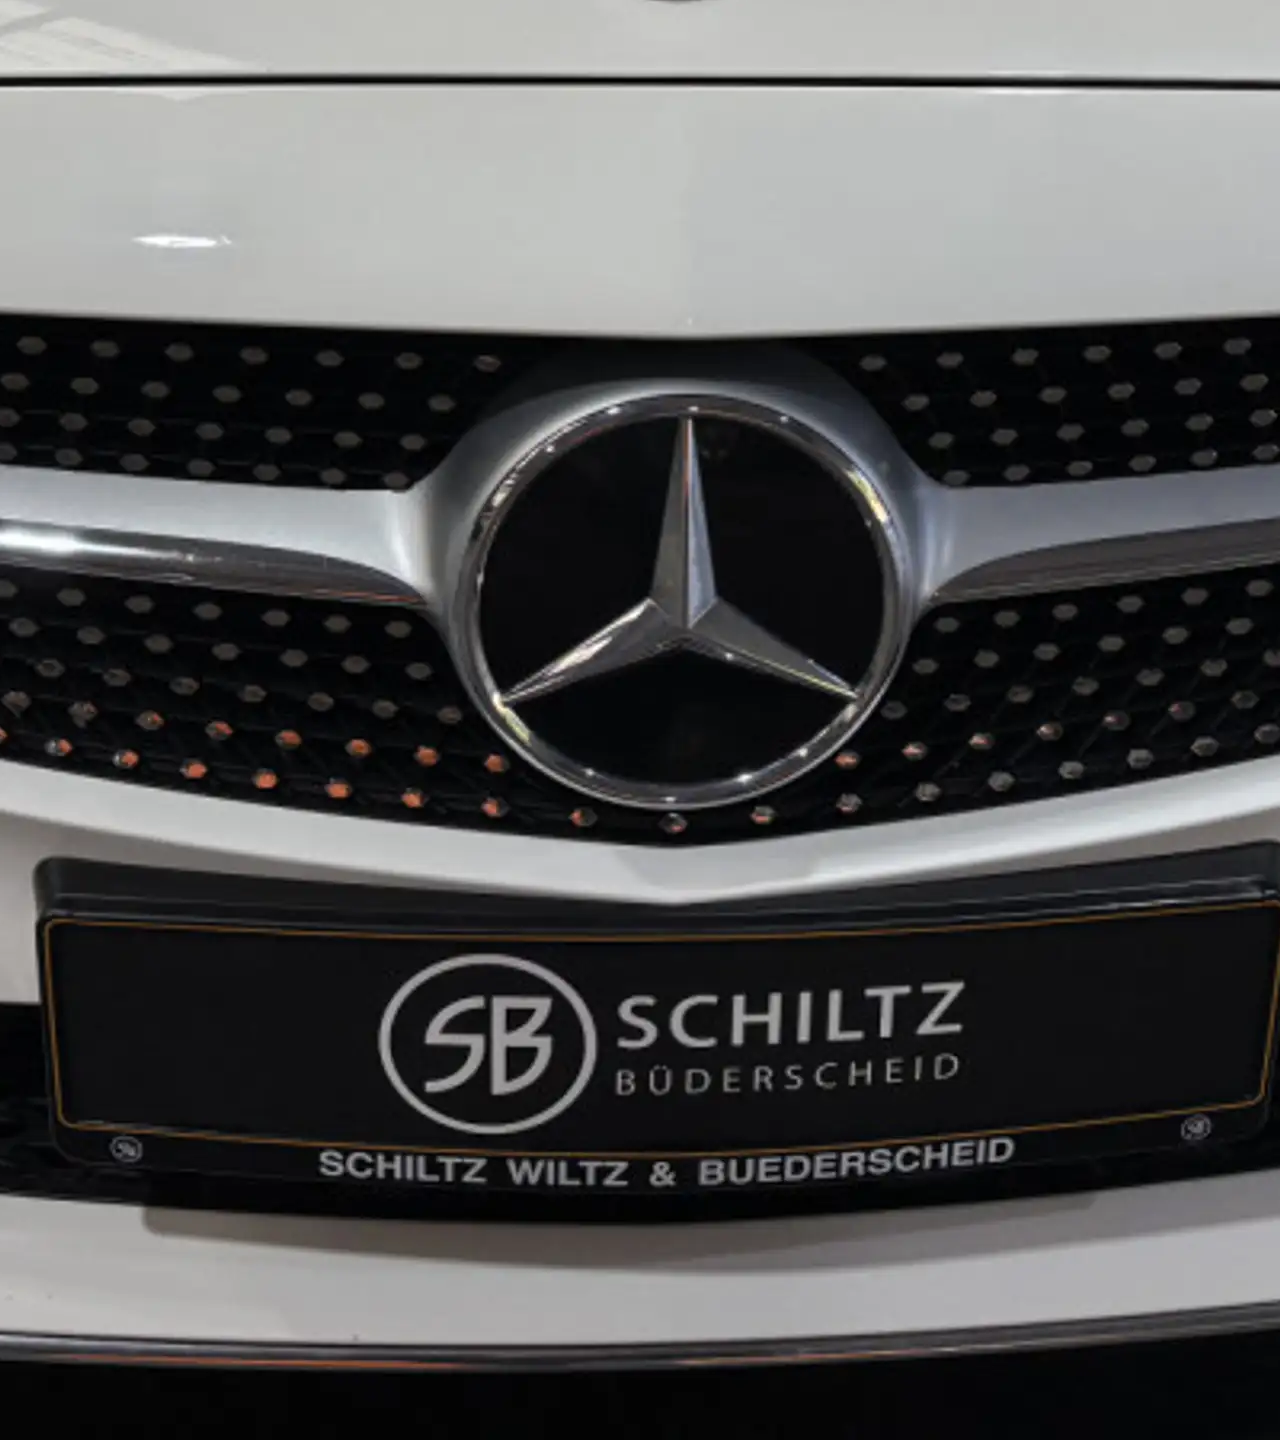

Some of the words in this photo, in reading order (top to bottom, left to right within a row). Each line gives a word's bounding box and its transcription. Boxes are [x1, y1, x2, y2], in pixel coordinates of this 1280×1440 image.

[616, 980, 966, 1049] SCHILTZ
[424, 995, 553, 1096] SB
[614, 1053, 960, 1097] BÜDERSCHEID
[319, 1149, 488, 1184] SCHILTZ
[505, 1160, 629, 1187] WILTZ
[649, 1161, 676, 1188] &
[697, 1136, 1015, 1188] BUEDERSCHEID
